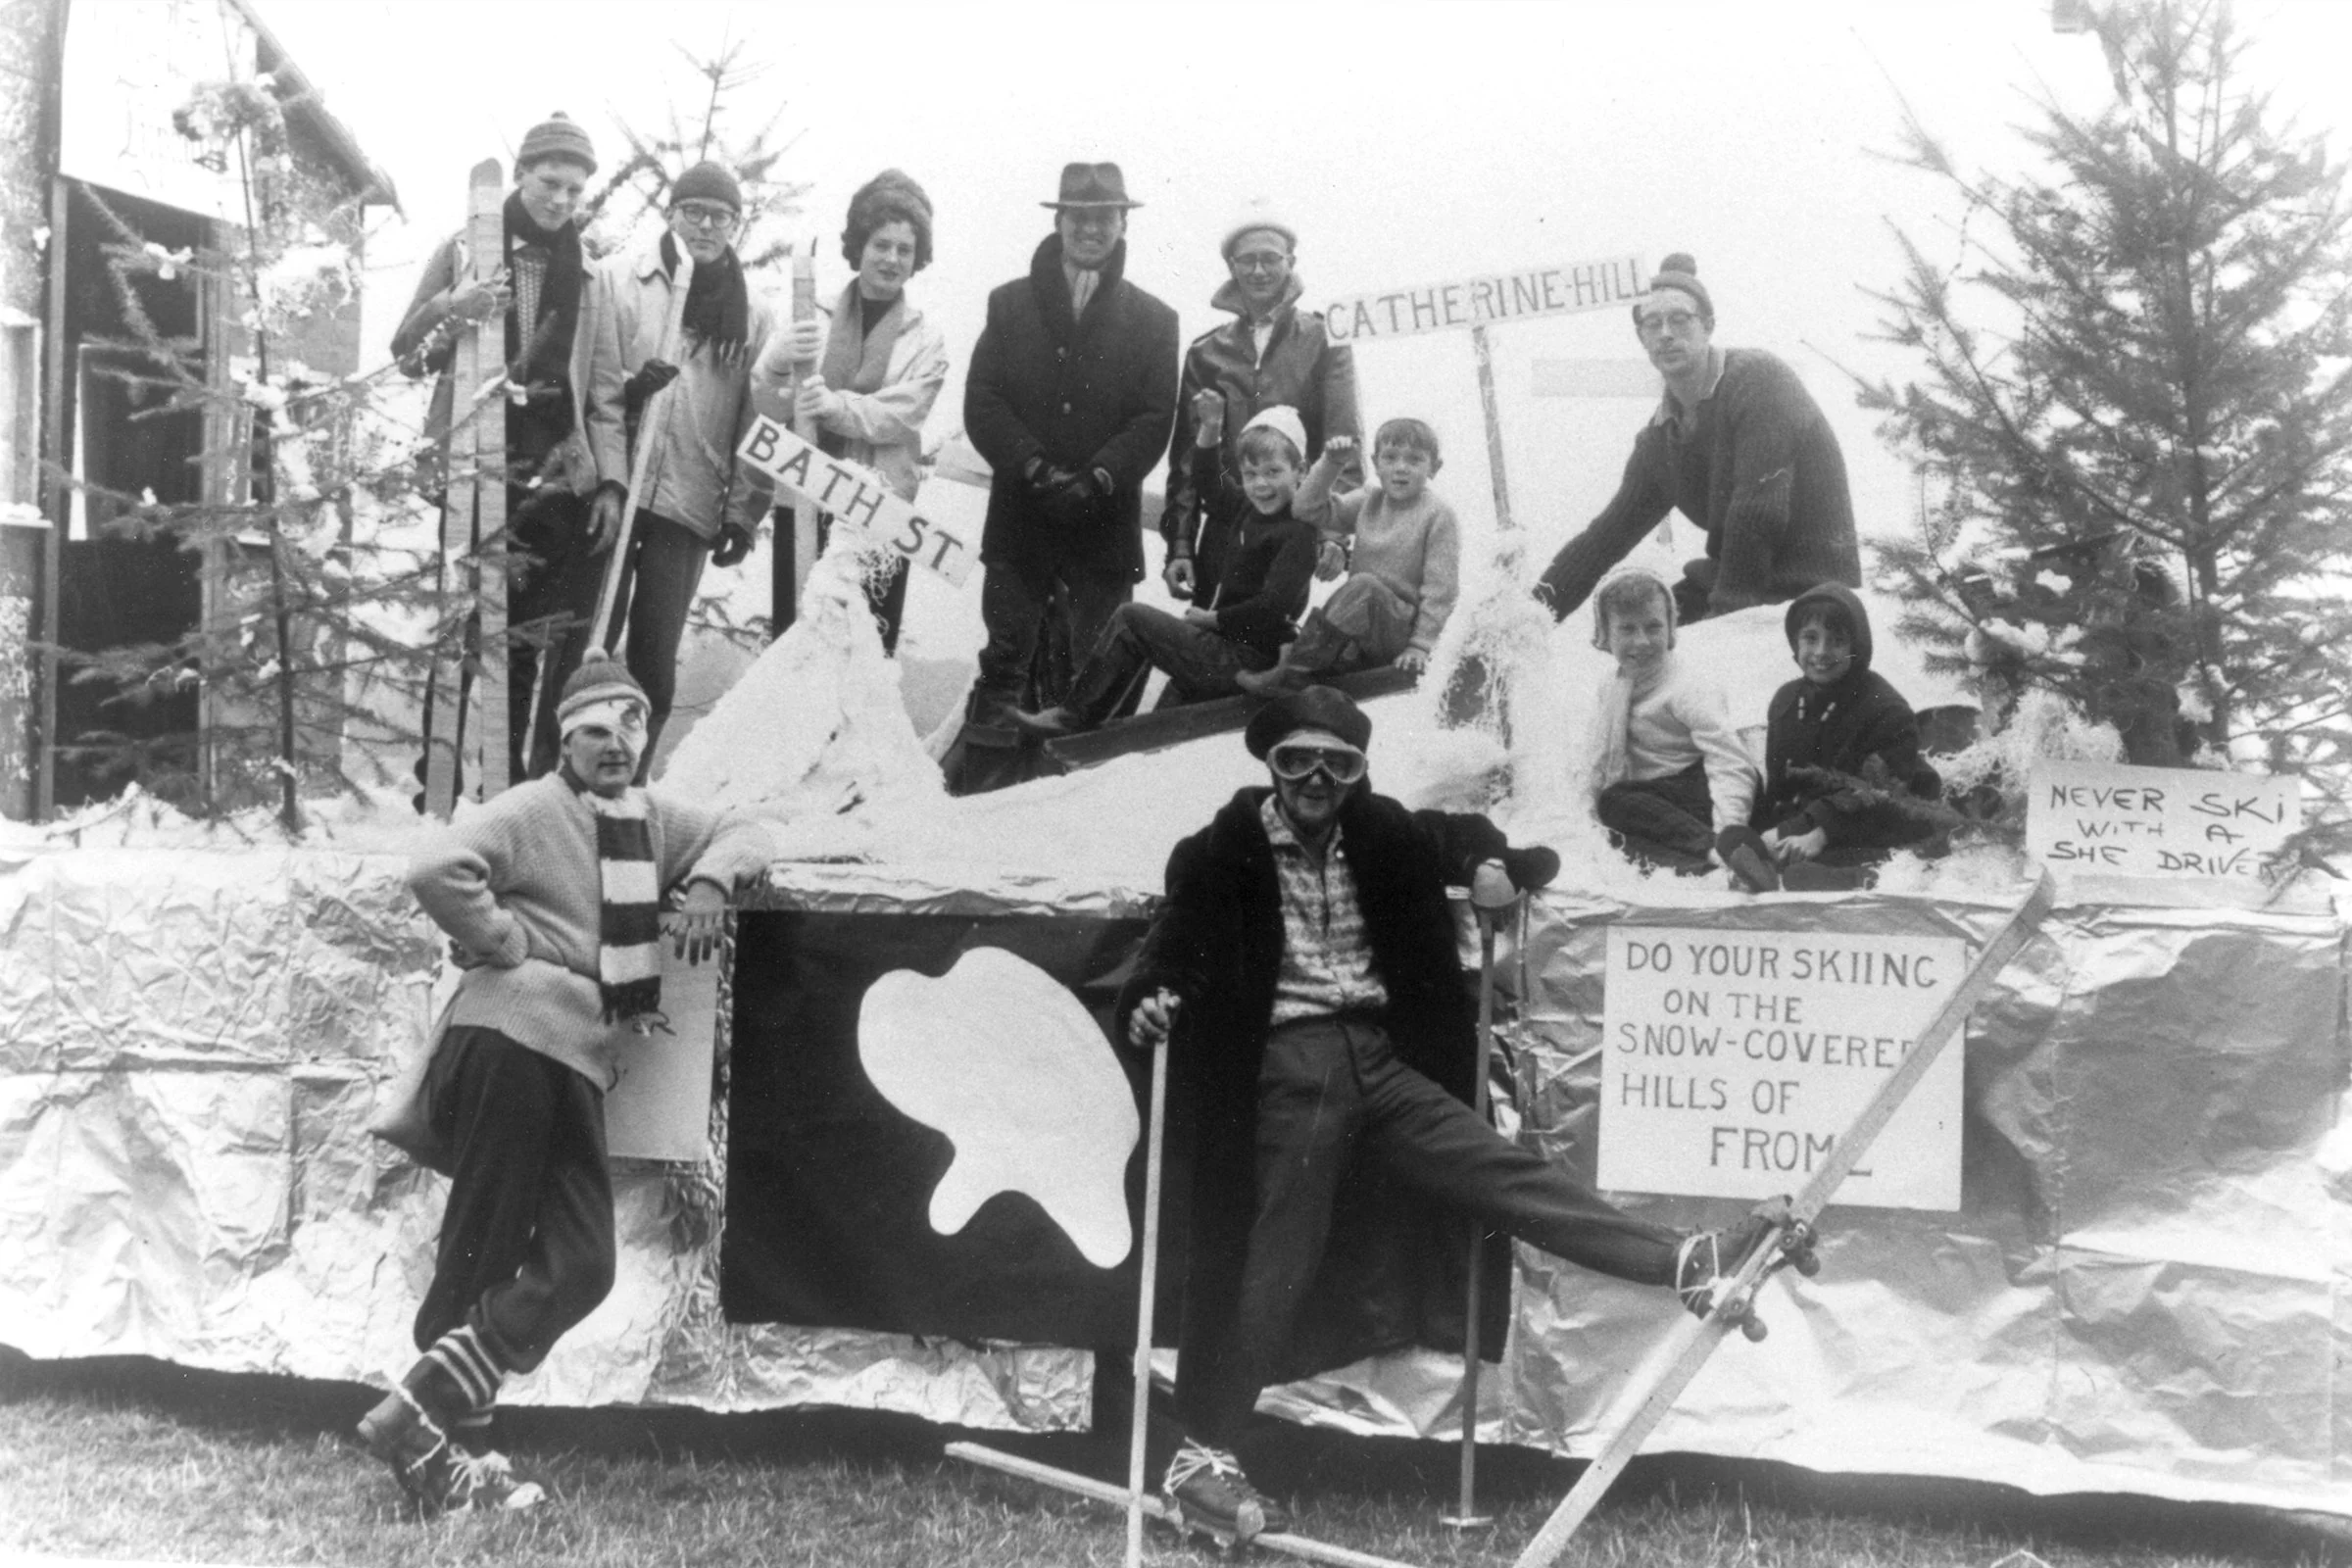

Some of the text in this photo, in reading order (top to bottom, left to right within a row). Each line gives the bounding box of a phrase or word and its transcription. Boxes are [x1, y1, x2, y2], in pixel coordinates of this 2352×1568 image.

[745, 421, 886, 528] BATH
[2049, 784, 2166, 813] NEVER
[2205, 822, 2245, 846] A
[2045, 841, 2130, 866] SHE
[1626, 941, 1673, 973] DO
[1688, 944, 1780, 979] YOUR
[1663, 988, 1803, 1024] ON THE
[1621, 1072, 1800, 1115] HILLS OF
[1709, 1125, 1873, 1178] FROM
